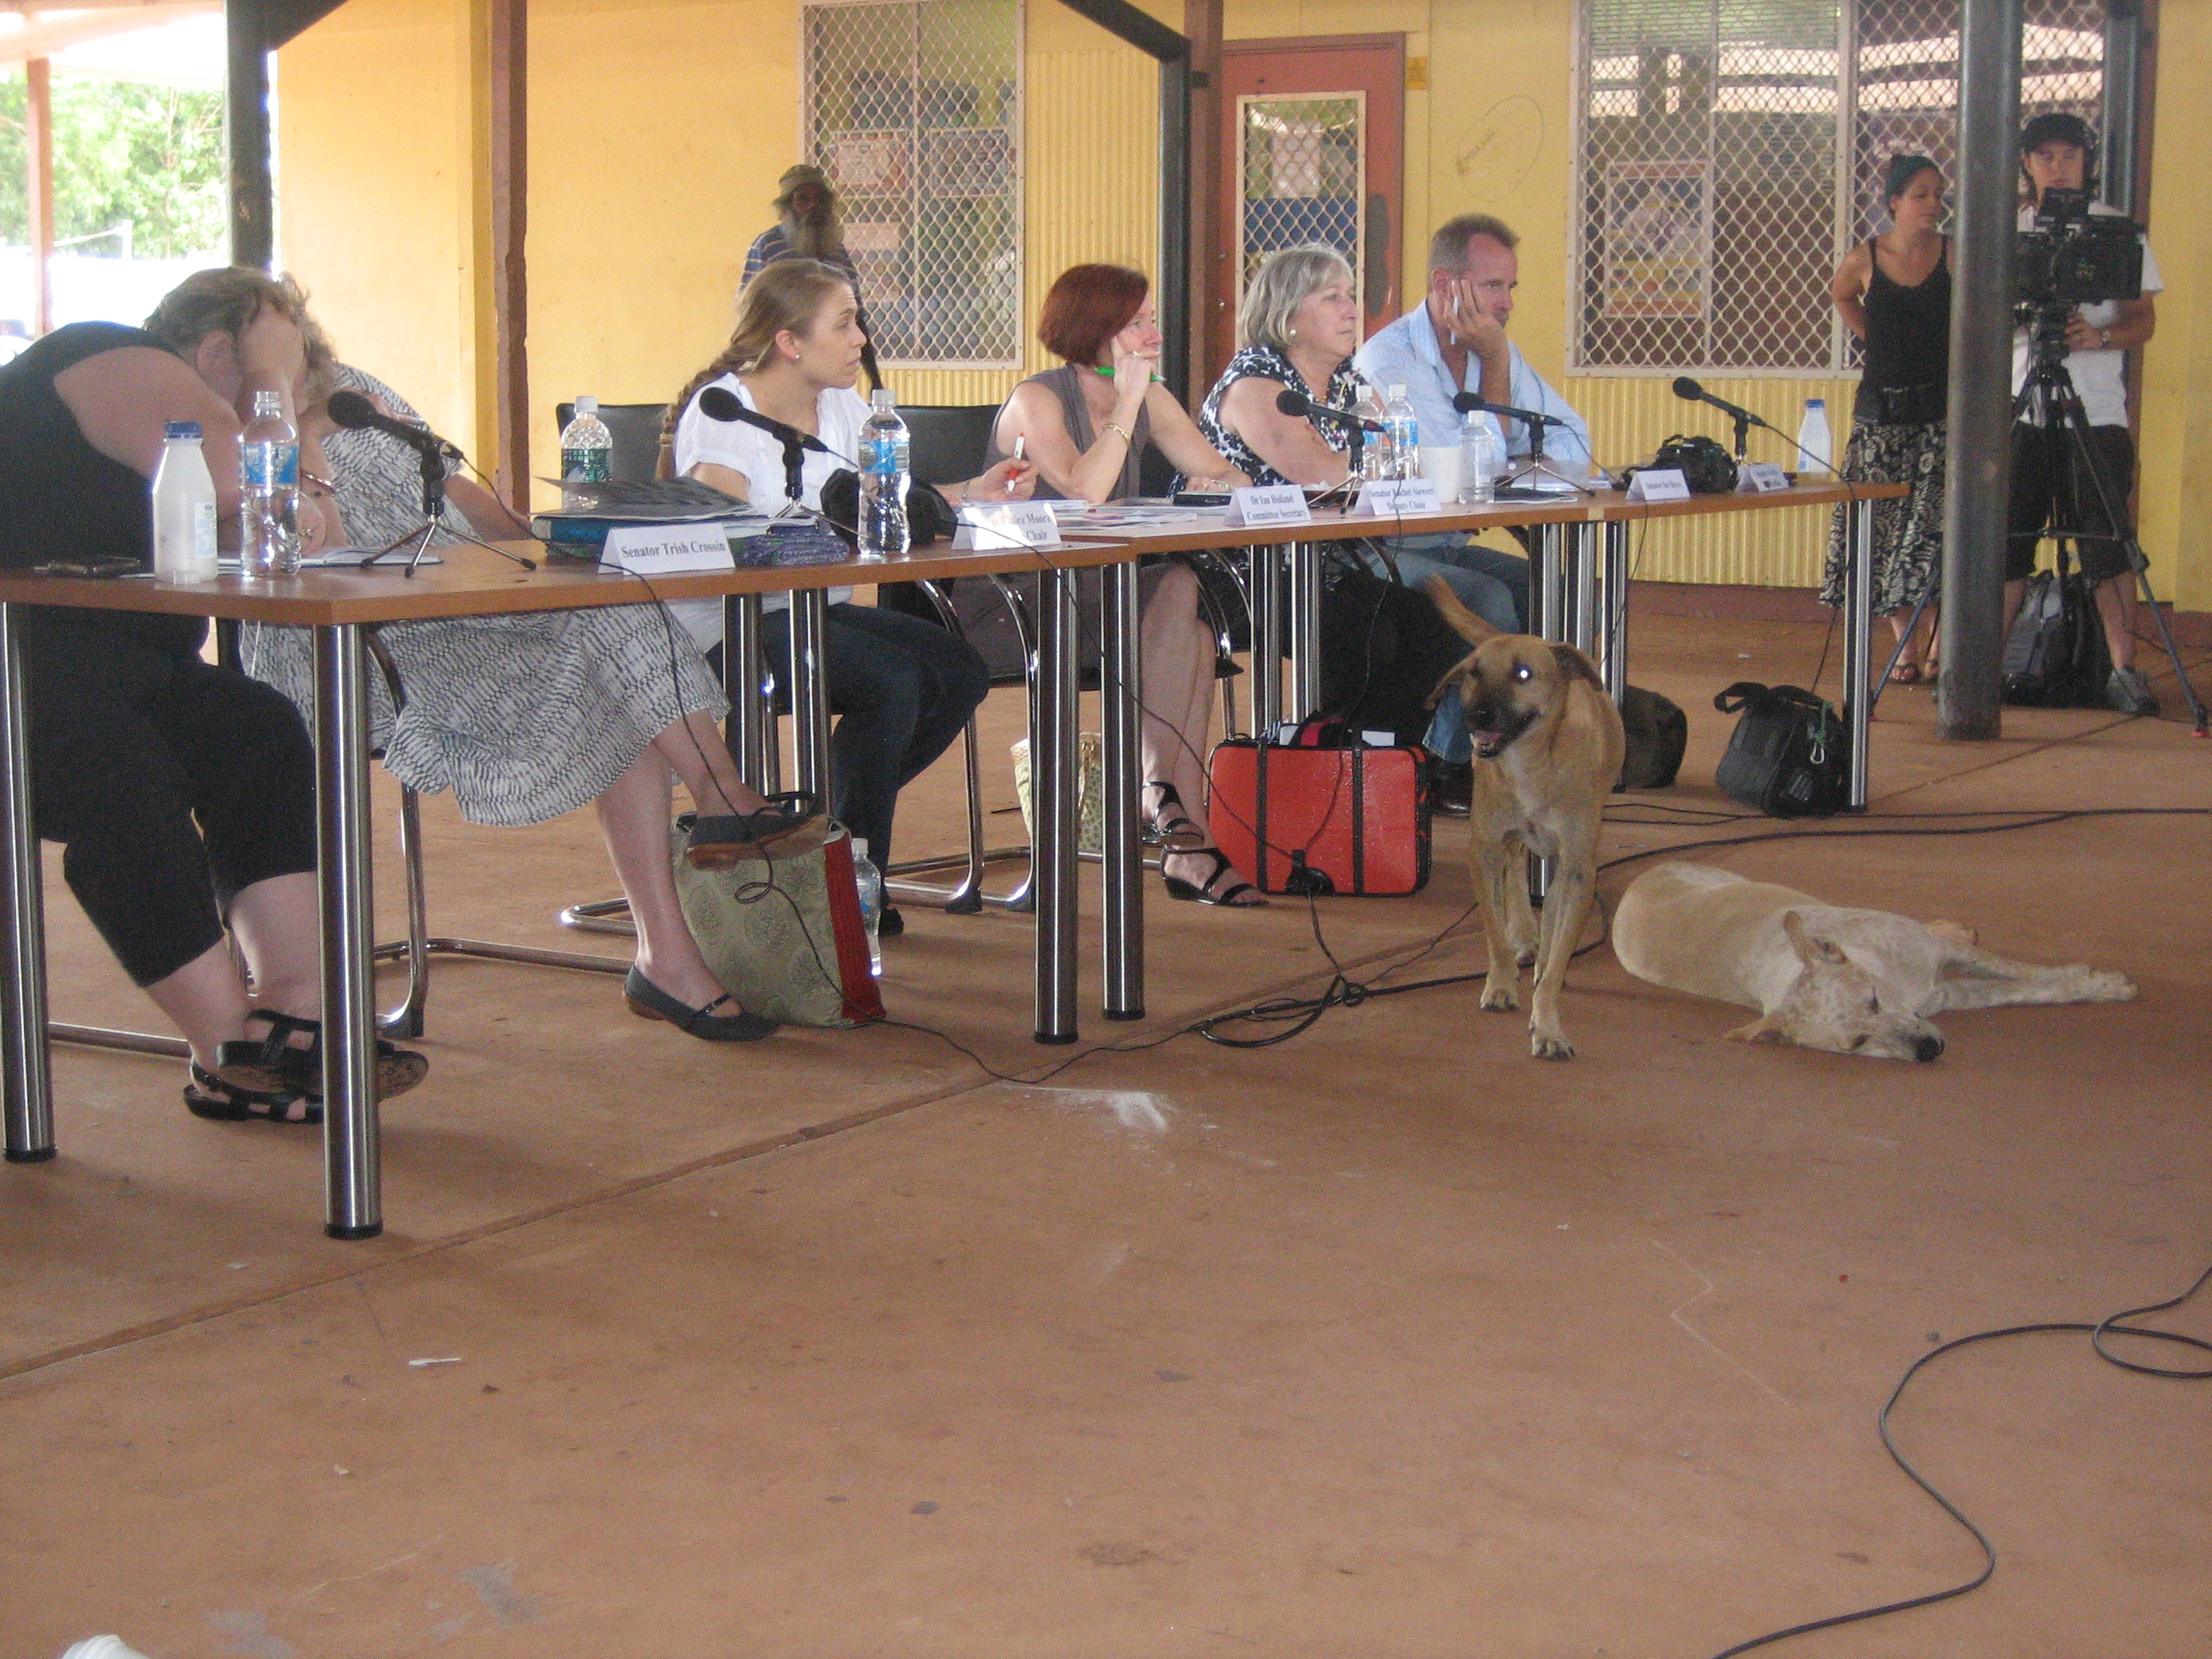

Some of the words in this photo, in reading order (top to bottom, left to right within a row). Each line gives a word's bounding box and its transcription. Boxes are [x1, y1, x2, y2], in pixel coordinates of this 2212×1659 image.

[1026, 529, 1048, 542] Chair
[620, 545, 660, 558] Senator
[661, 542, 689, 555] Trish
[690, 539, 726, 553] Crossin
